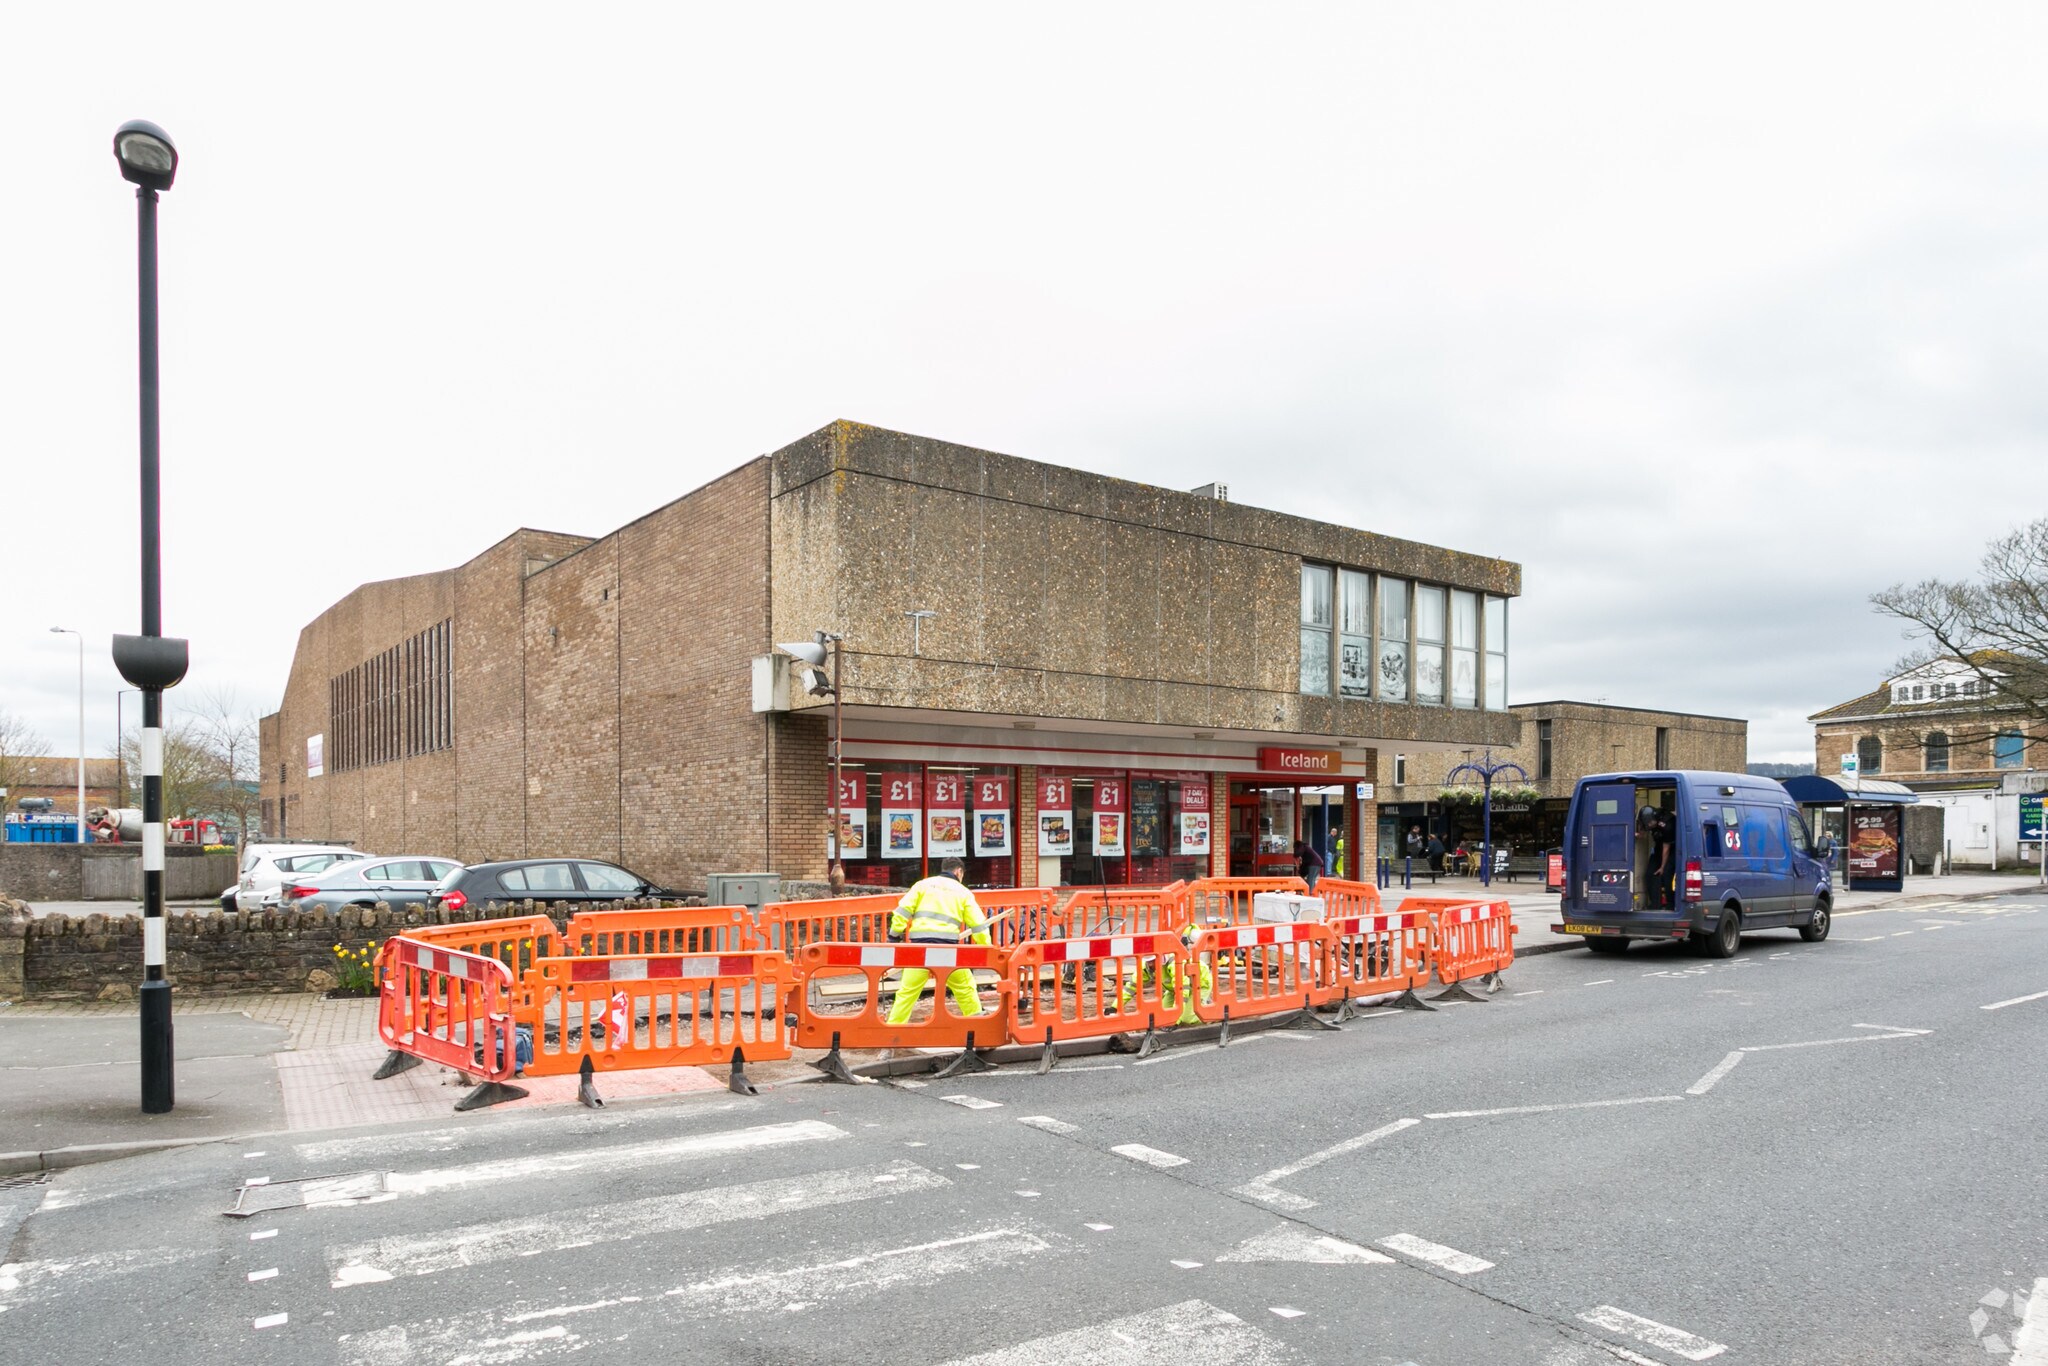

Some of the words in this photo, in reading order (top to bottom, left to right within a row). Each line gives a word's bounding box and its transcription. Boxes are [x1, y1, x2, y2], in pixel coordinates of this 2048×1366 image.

[1280, 752, 1328, 769] Iceland
[891, 780, 913, 801] £1
[936, 781, 957, 802] £1
[982, 782, 1003, 802] £1
[1046, 784, 1065, 803] £1
[1101, 787, 1119, 805] £1
[1385, 806, 1399, 815] HILL
[1725, 830, 1741, 851] G4S
[1602, 873, 1618, 884] G4S
